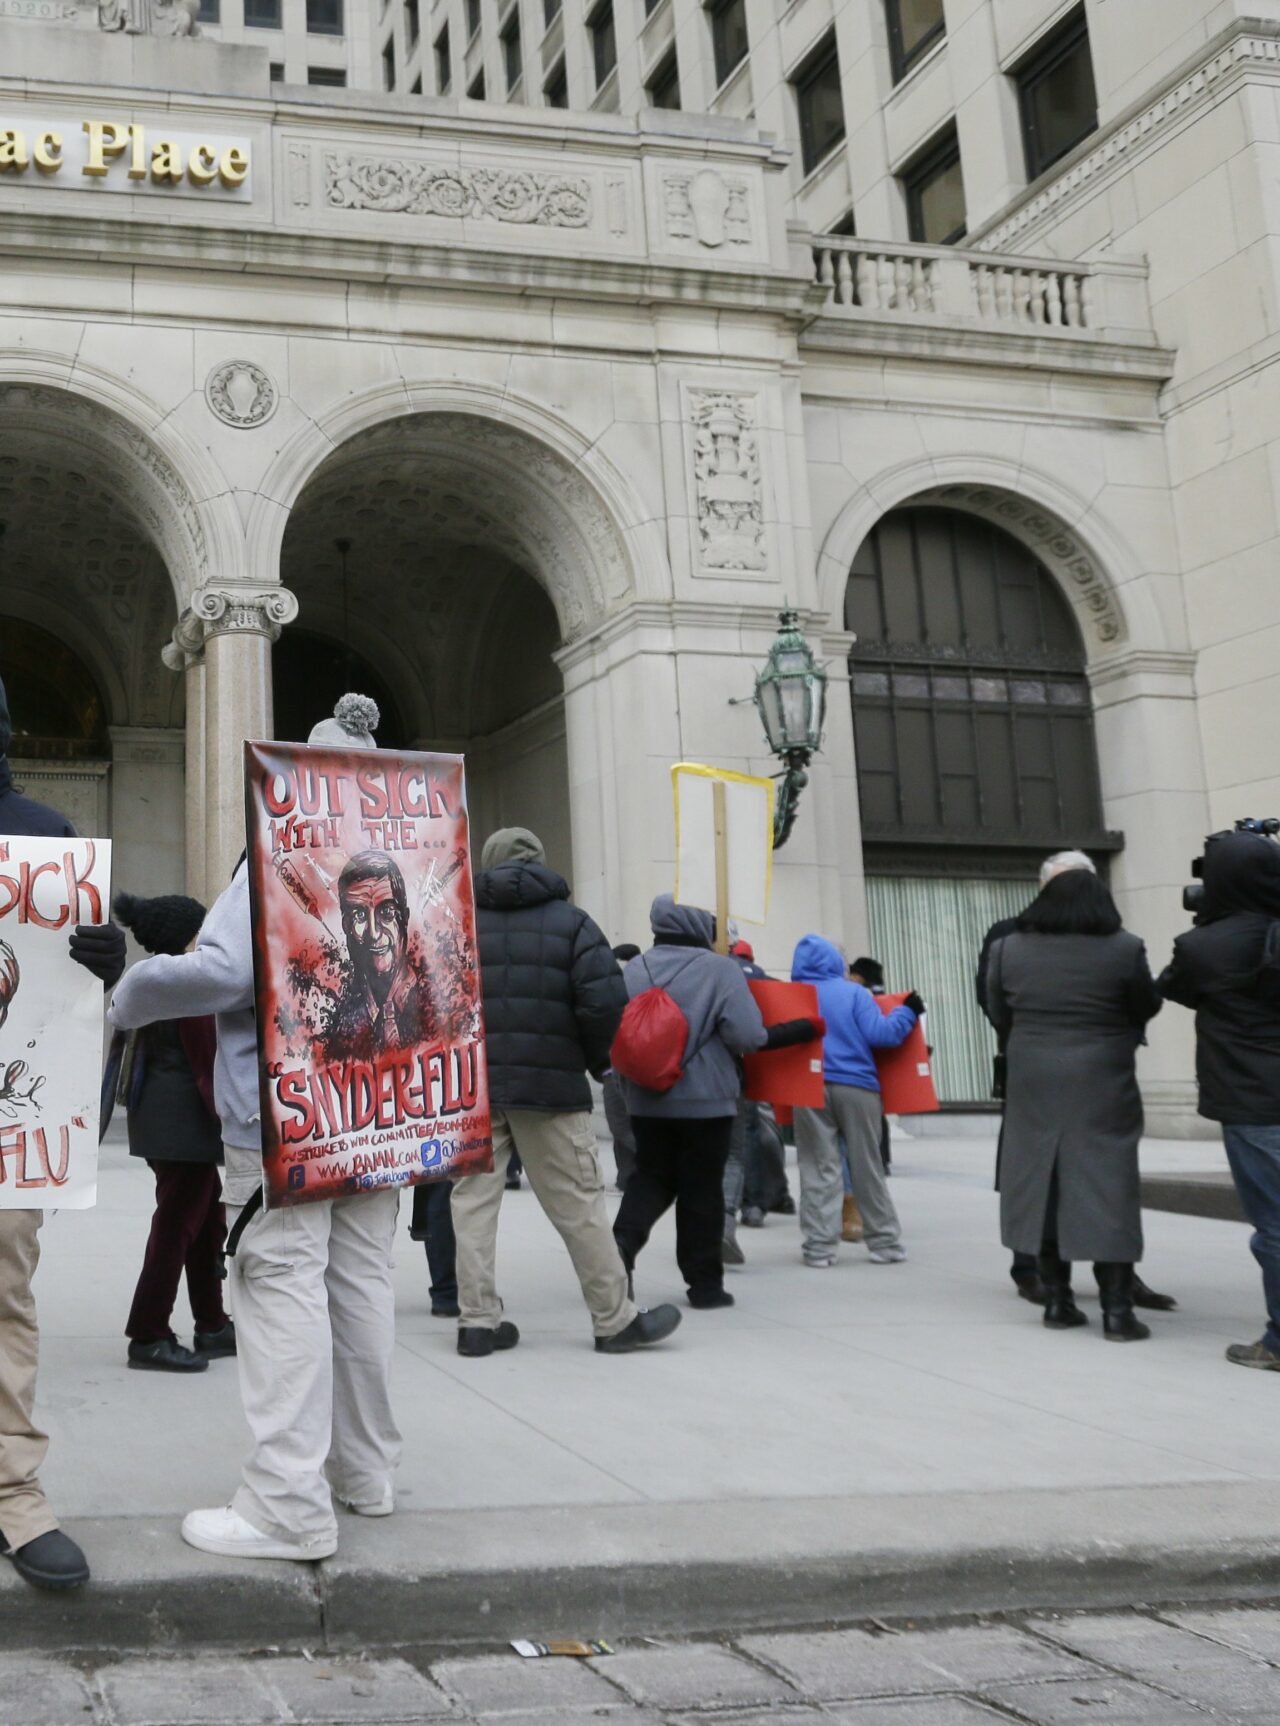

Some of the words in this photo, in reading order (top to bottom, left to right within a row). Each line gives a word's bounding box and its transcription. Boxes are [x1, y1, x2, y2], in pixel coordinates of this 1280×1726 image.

[82, 120, 249, 188] Place
[260, 765, 348, 818] OUT
[356, 766, 464, 821] SICK
[269, 814, 341, 853] WITH
[349, 1134, 369, 1148] WIN
